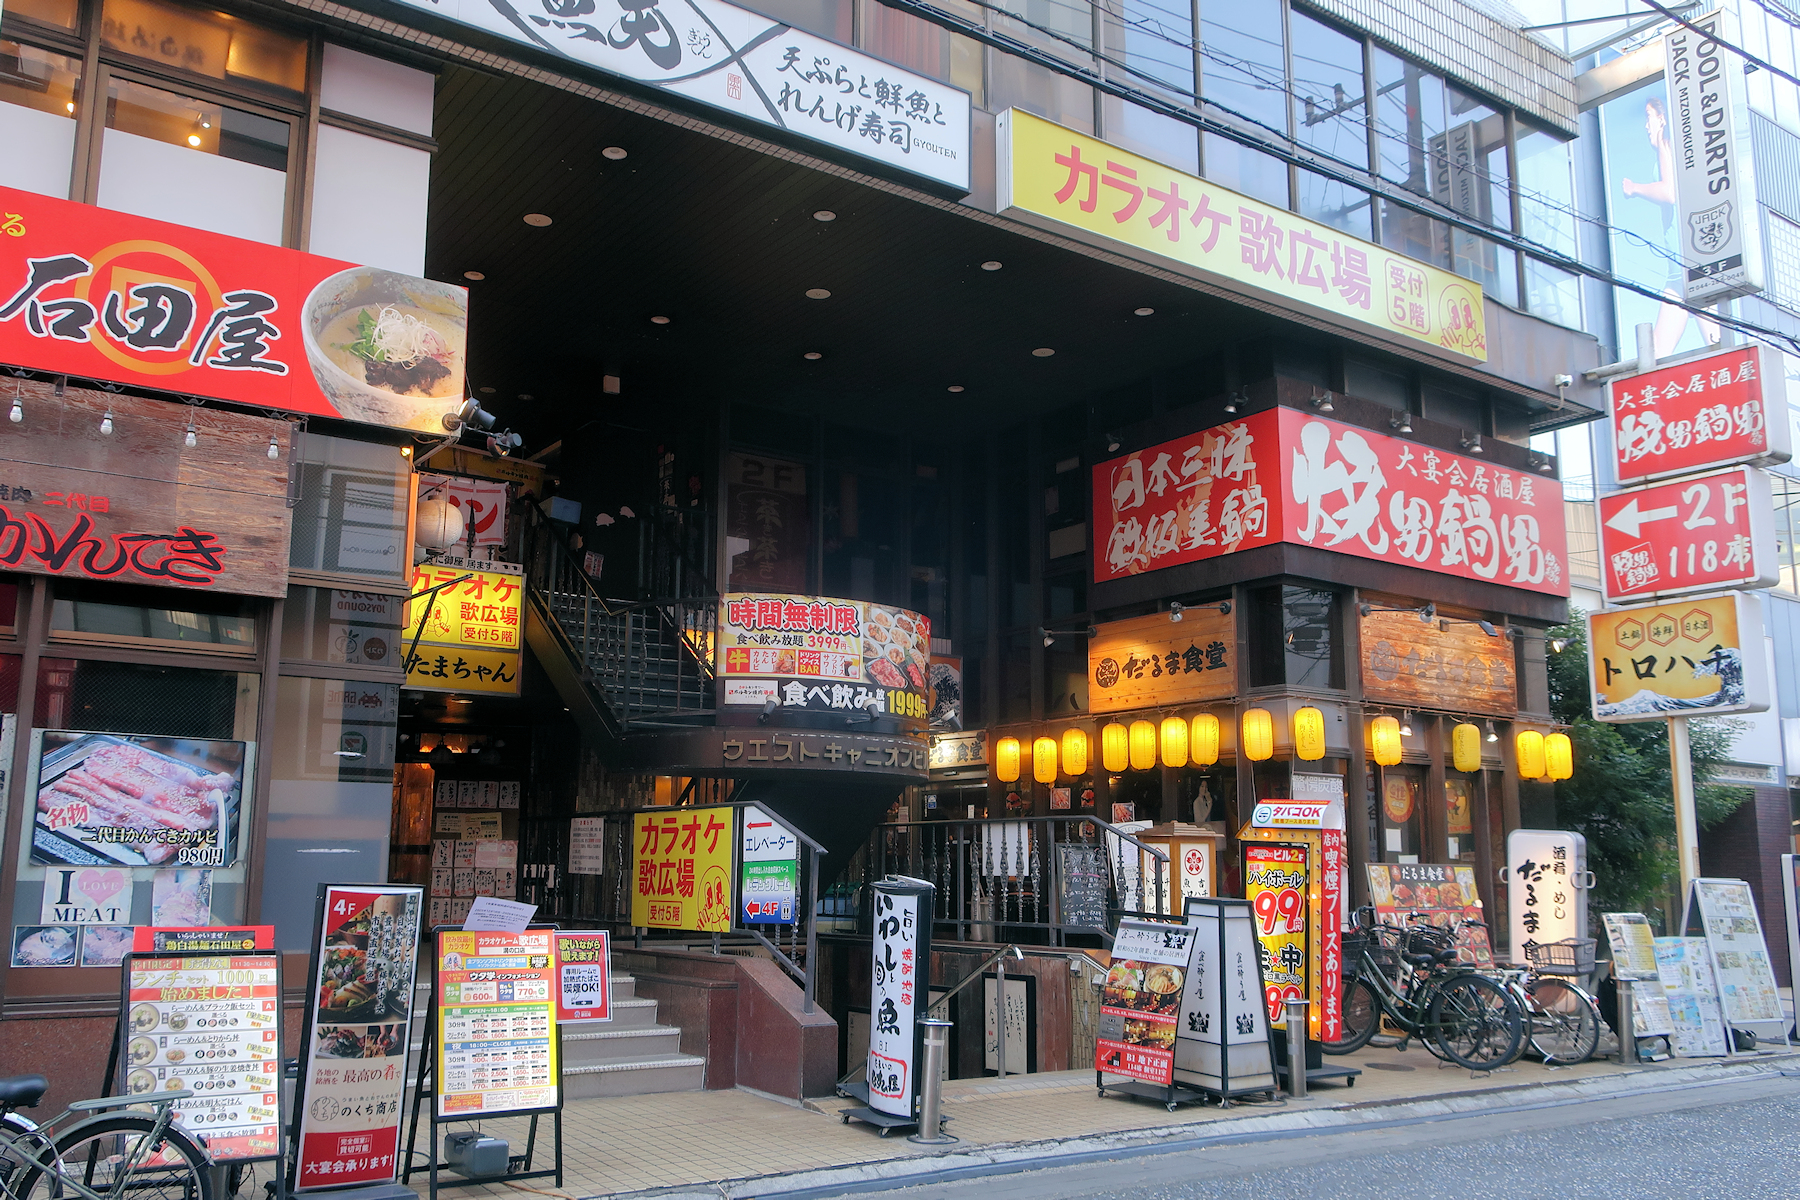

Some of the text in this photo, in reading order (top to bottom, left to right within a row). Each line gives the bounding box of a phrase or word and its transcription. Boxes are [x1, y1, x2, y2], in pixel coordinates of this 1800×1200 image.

[776, 46, 947, 126] 天ぷらと鮮魚と
[777, 81, 912, 154] れんげ寿司
[913, 137, 958, 160] GYOUTEN
[1695, 206, 1726, 225] JACK
[1054, 145, 1372, 309] カラオケ歌広場
[1389, 264, 1424, 297] 受付
[0, 253, 289, 377] 石田屋
[1392, 296, 1426, 330] 5階
[1616, 360, 1757, 411] 大宴会居酒屋
[1618, 400, 1764, 464] 焼男鍋男
[1395, 446, 1537, 507] 大宴会居酒屋
[43, 491, 110, 513] 二代目
[1682, 482, 1747, 531] 2F
[1669, 534, 1752, 578] 118席
[413, 567, 520, 602] カラオケ
[460, 602, 519, 626] 歌広場
[728, 597, 860, 637] 時間無制限
[464, 627, 513, 643] 受付5階
[736, 633, 804, 648] 食べ飲み放題
[728, 648, 749, 672] 牛
[752, 650, 760, 671] カルビ
[761, 650, 769, 664] たん
[1121, 641, 1229, 682] だるま食堂
[1603, 643, 1734, 687] トロハチ
[799, 665, 820, 675] BAR
[1404, 646, 1509, 691] だるま食堂
[46, 803, 91, 830] 名物
[1273, 806, 1323, 818] タバコOK
[81, 826, 219, 845] 二代目かんてきカルビ
[640, 814, 725, 855] カラオケ
[745, 835, 794, 852] エレベーター
[1323, 833, 1340, 847] 店内
[178, 847, 225, 866] 980円
[638, 858, 695, 898] 歌広場
[745, 876, 791, 892] トランクルーム
[1248, 869, 1305, 888] ハイボール
[1401, 865, 1446, 882] だるま食堂
[55, 870, 76, 905] I
[82, 881, 120, 892] LOVE
[52, 907, 122, 922] MEAT
[333, 898, 356, 916] 4F
[649, 905, 681, 923] 受付5階
[761, 901, 779, 915] 4F
[559, 938, 602, 950] 歌いながら
[1324, 848, 1340, 1039] 喫煙ブースあります
[561, 950, 600, 962] 吸えます!
[131, 971, 183, 987] ランチ
[217, 970, 254, 984] 1000
[563, 983, 599, 993] 喫煙OK!
[160, 984, 254, 1001] 始めました！
[316, 1068, 339, 1077] 各地の
[341, 1099, 398, 1117] のくち商店
[305, 1154, 394, 1175] 大宴会承ります!
